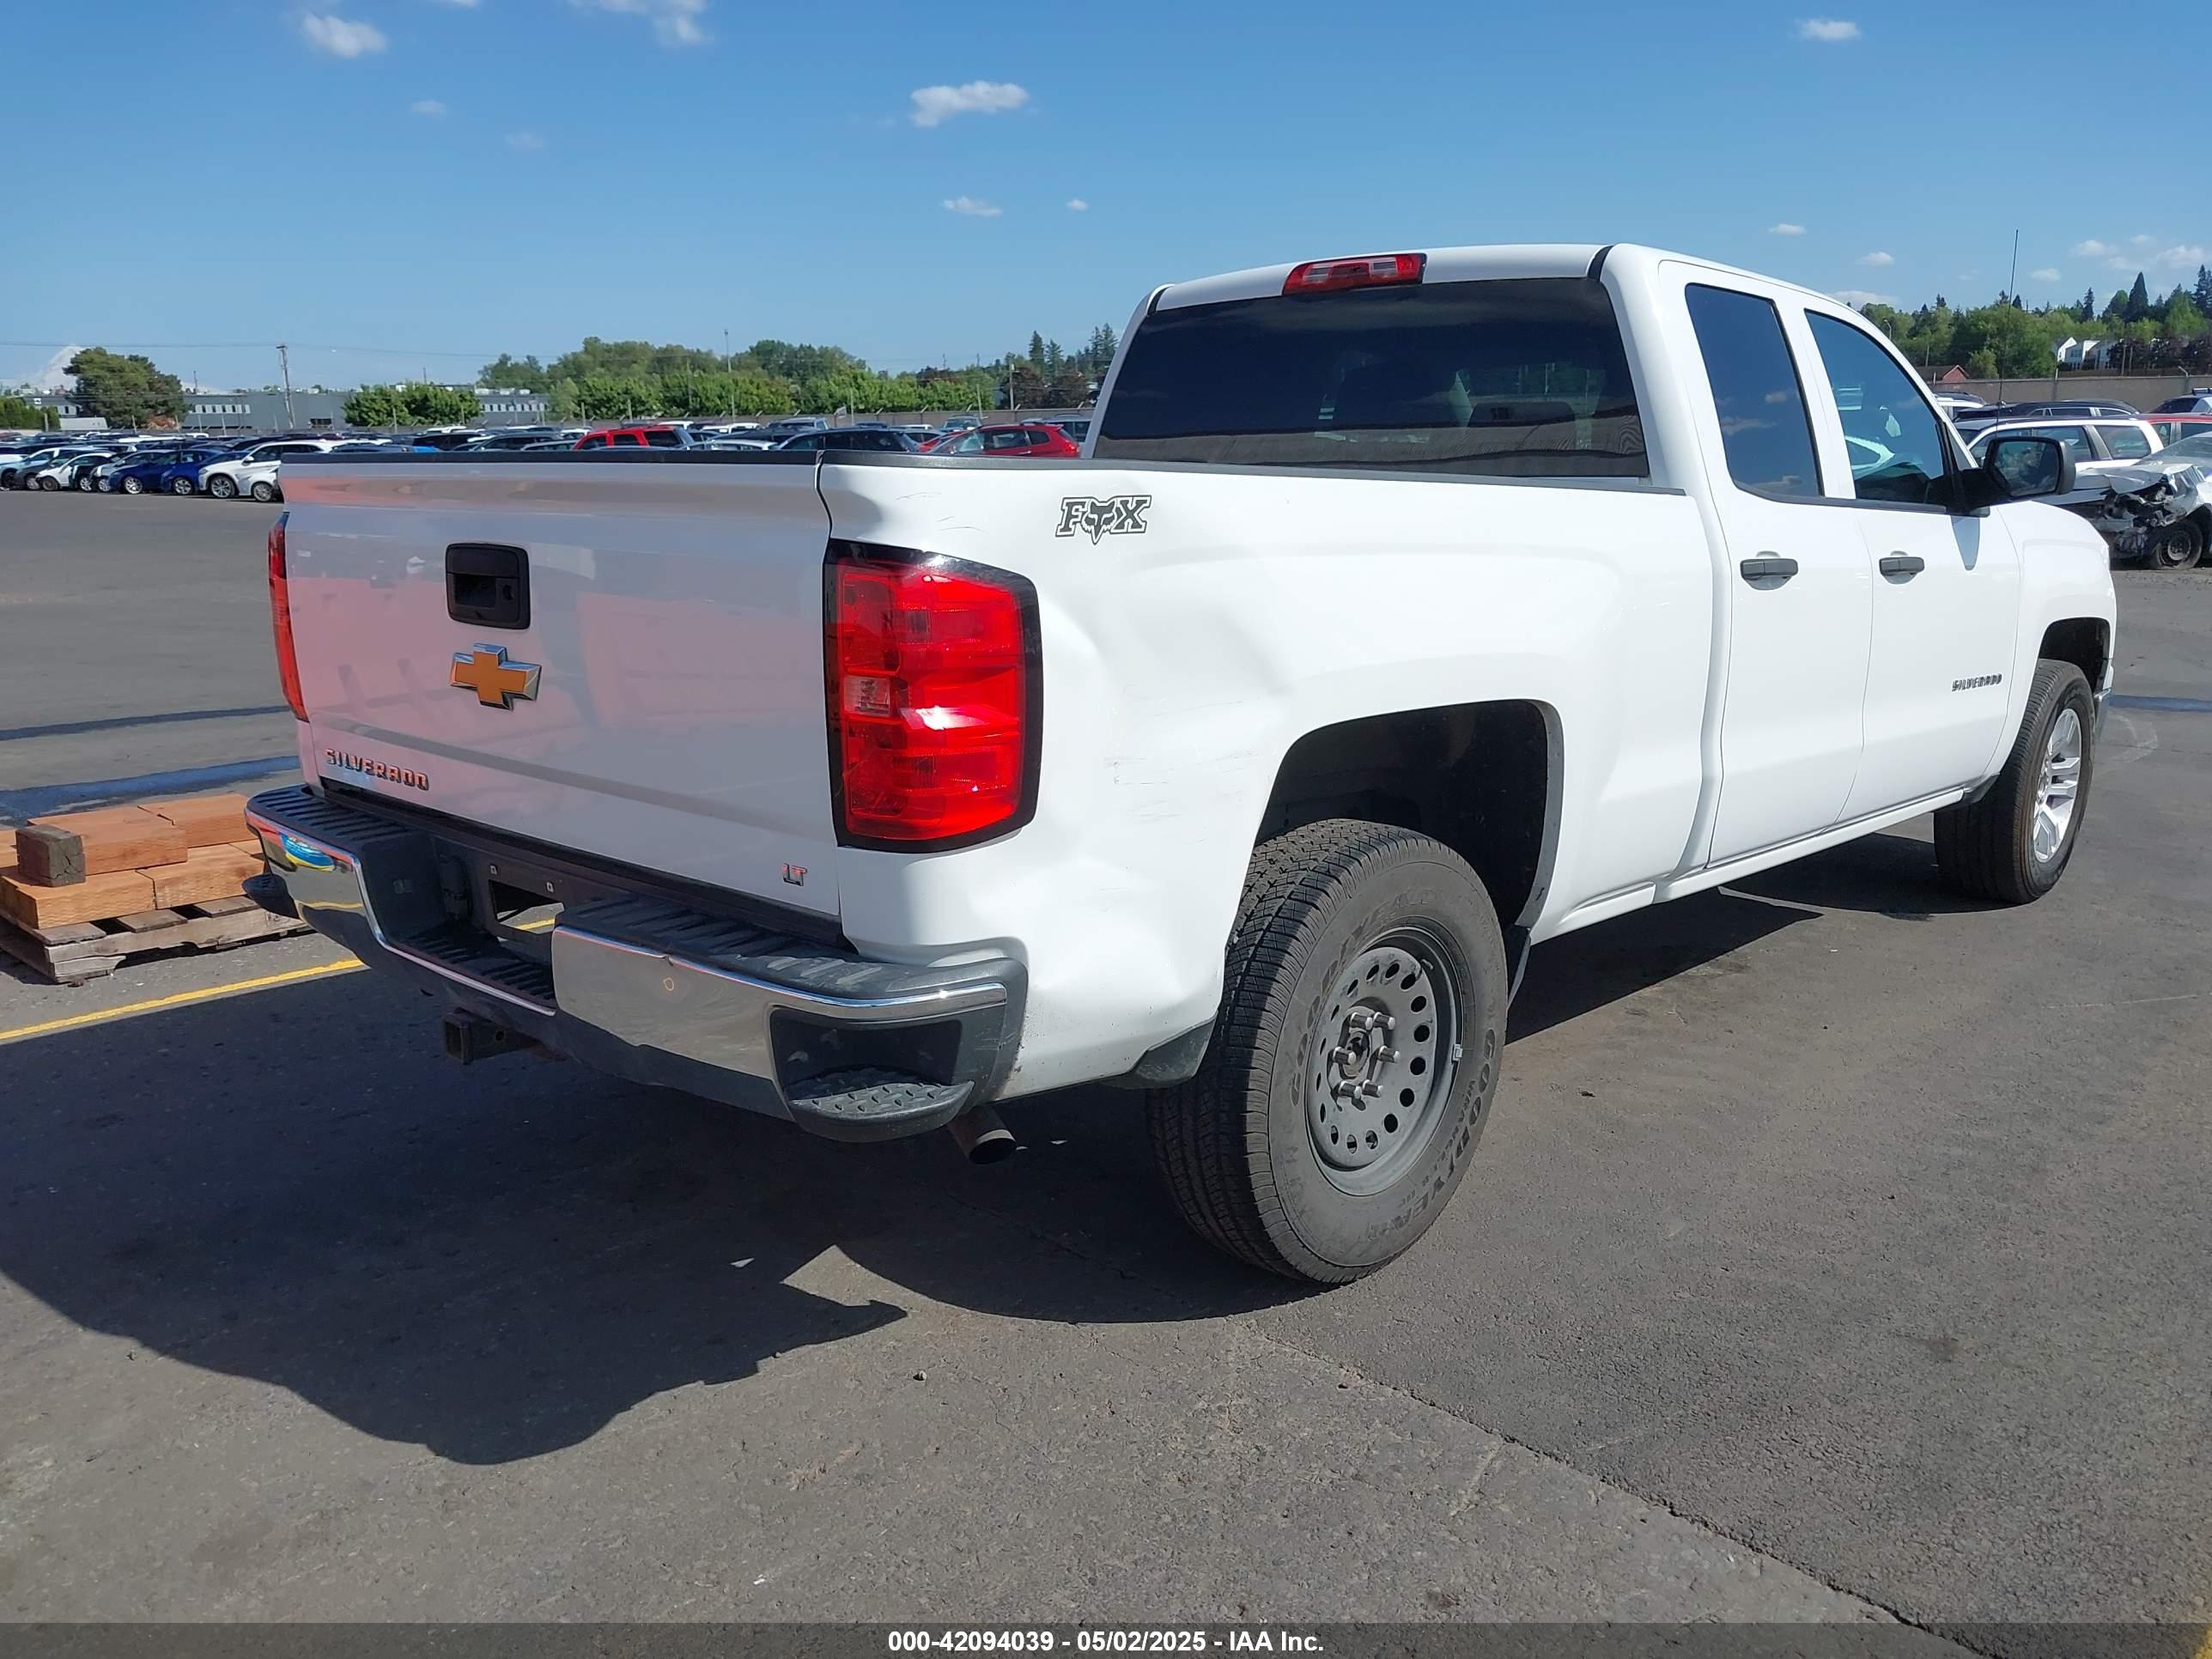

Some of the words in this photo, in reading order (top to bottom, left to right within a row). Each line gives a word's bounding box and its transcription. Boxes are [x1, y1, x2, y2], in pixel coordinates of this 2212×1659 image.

[1951, 673, 2002, 692] SILVERADO
[325, 749, 429, 791] SILVERADO
[782, 863, 808, 886] LT
